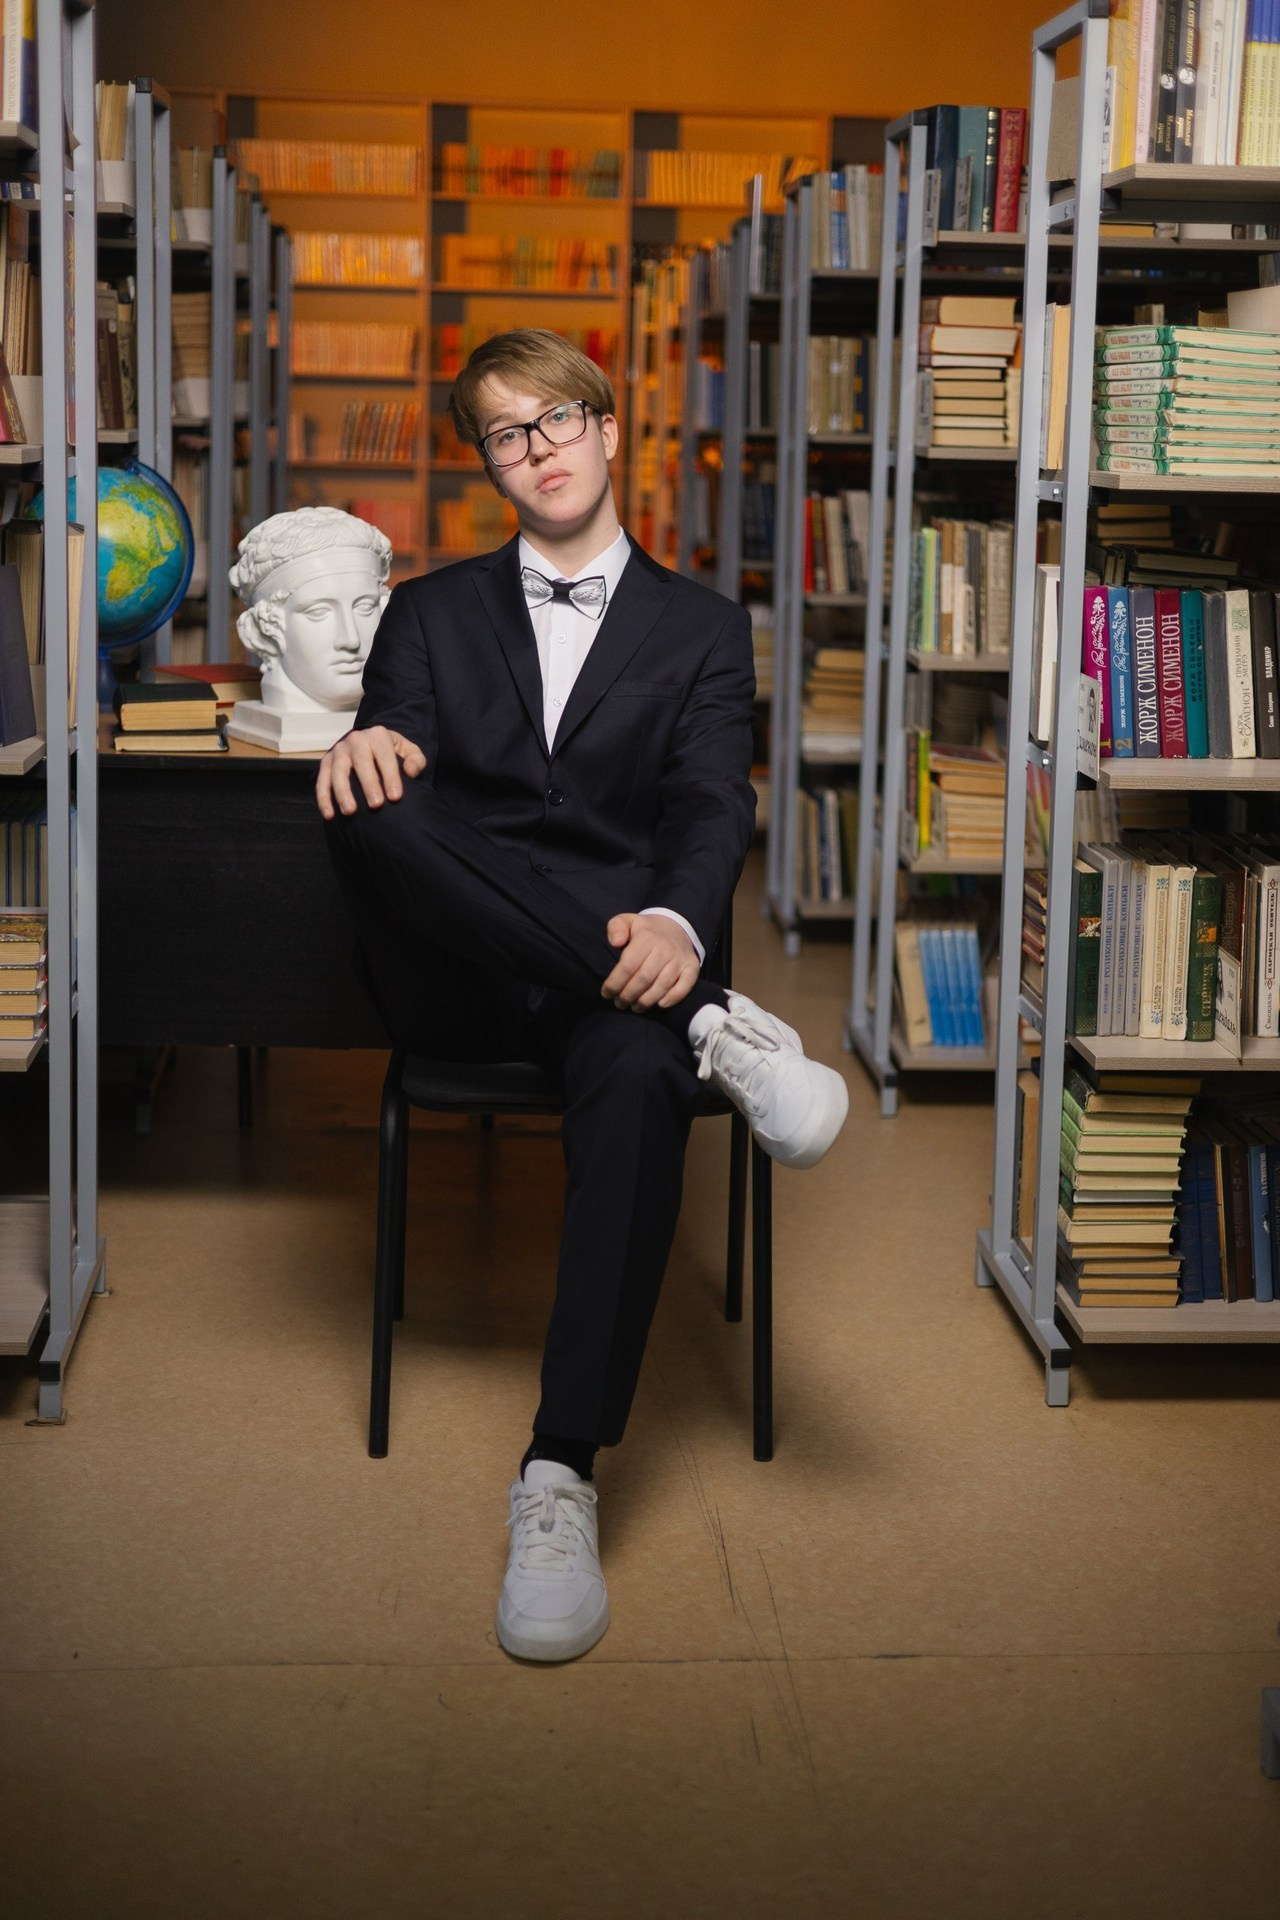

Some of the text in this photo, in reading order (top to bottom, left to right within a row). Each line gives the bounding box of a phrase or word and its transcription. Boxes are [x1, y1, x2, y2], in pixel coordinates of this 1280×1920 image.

[1234, 635, 1242, 678] ПРИЗНАНИЯ
[1241, 654, 1249, 677] МЕГРЭ
[1264, 646, 1273, 678] ВЛАДИМИР
[1135, 615, 1158, 744] ЖОРЖ СИМЕНОН
[1161, 613, 1184, 743] ЖОРЖ СИМЕНОН
[1237, 713, 1245, 736] ЖОРЖ
[1241, 688, 1252, 737] СИМЕНОН
[1115, 737, 1132, 750] 2
[1106, 884, 1114, 921] КОНЬКИ
[1120, 885, 1128, 921] КОНЬКИ
[1134, 885, 1142, 921] КОНЬКИ
[1104, 925, 1113, 978] РОЛИКОВЫЕ
[1117, 925, 1127, 978] РОЛИКОВЫЕ
[1132, 925, 1141, 977] РОЛИКОВЫЕ
[1215, 1008, 1235, 1036] тендаль
[1264, 992, 1273, 1029] Стендаль
